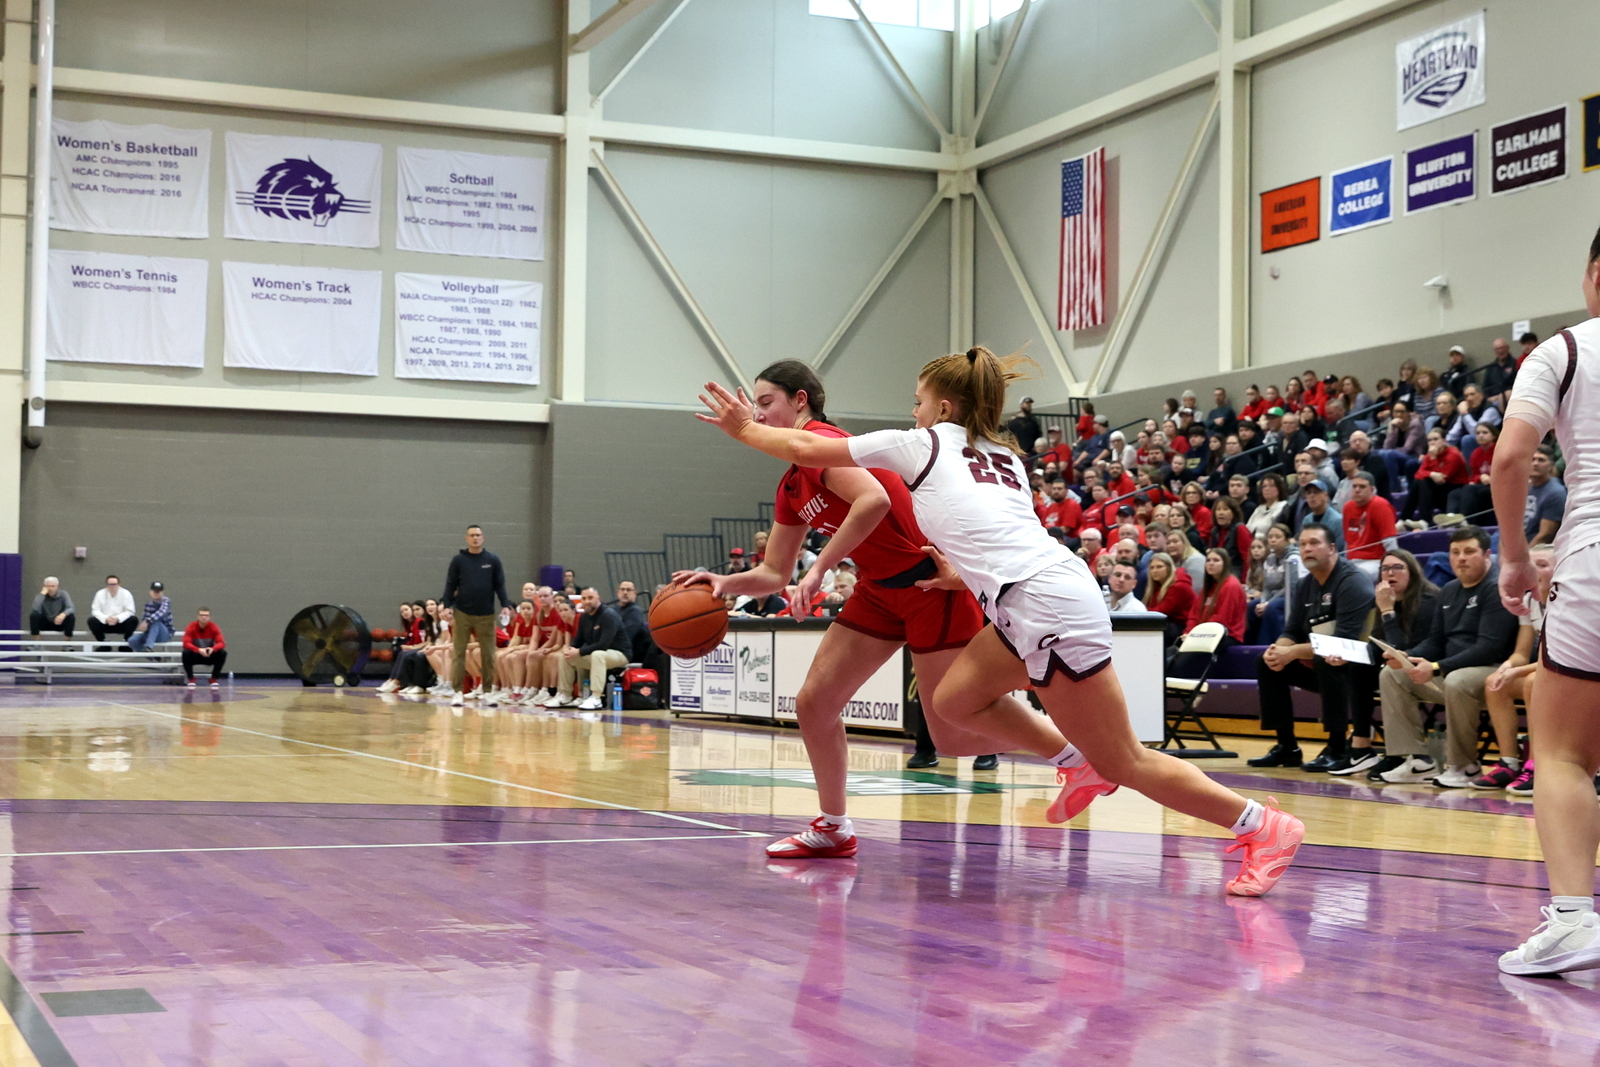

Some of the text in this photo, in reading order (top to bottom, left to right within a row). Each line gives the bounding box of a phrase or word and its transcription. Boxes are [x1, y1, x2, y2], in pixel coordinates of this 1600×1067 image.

[1403, 45, 1477, 94] HEARTLAND
[57, 135, 198, 157] Women's Basketball
[1495, 122, 1561, 157] EARLHAM
[75, 154, 98, 164] AMC
[100, 156, 154, 167] Champions:
[1415, 151, 1466, 177] BLUFFTON
[1496, 149, 1558, 181] COLLEGE
[72, 168, 181, 182] HCAC Champions: 2016
[450, 173, 494, 186] Softball
[1409, 168, 1472, 197] UNIVERSITY
[71, 183, 182, 198] NCAA Tournament: 2016
[452, 188, 497, 198] Champions:
[1343, 177, 1379, 198] BEREA
[1338, 192, 1384, 216] COLLEGE
[428, 218, 474, 229] Champions:
[71, 265, 178, 283] Women's Tennis
[72, 280, 101, 289] WBCC
[103, 282, 153, 292] Champions:
[252, 277, 351, 294] Women's Track
[442, 281, 499, 296] Volleyball
[251, 292, 352, 305] HCAC Champions: 2004
[400, 292, 420, 300] NAIA
[422, 293, 466, 303] Champions
[468, 296, 500, 306] (District
[399, 313, 425, 322] WBCC
[427, 314, 473, 325] Champions:
[411, 335, 436, 344] HCAC
[438, 337, 484, 347] Champions:
[510, 341, 527, 349] 2011
[409, 347, 433, 355] NCAA
[436, 348, 483, 358] Tournament:
[962, 447, 1022, 492] 25
[704, 648, 734, 664] STOLLY
